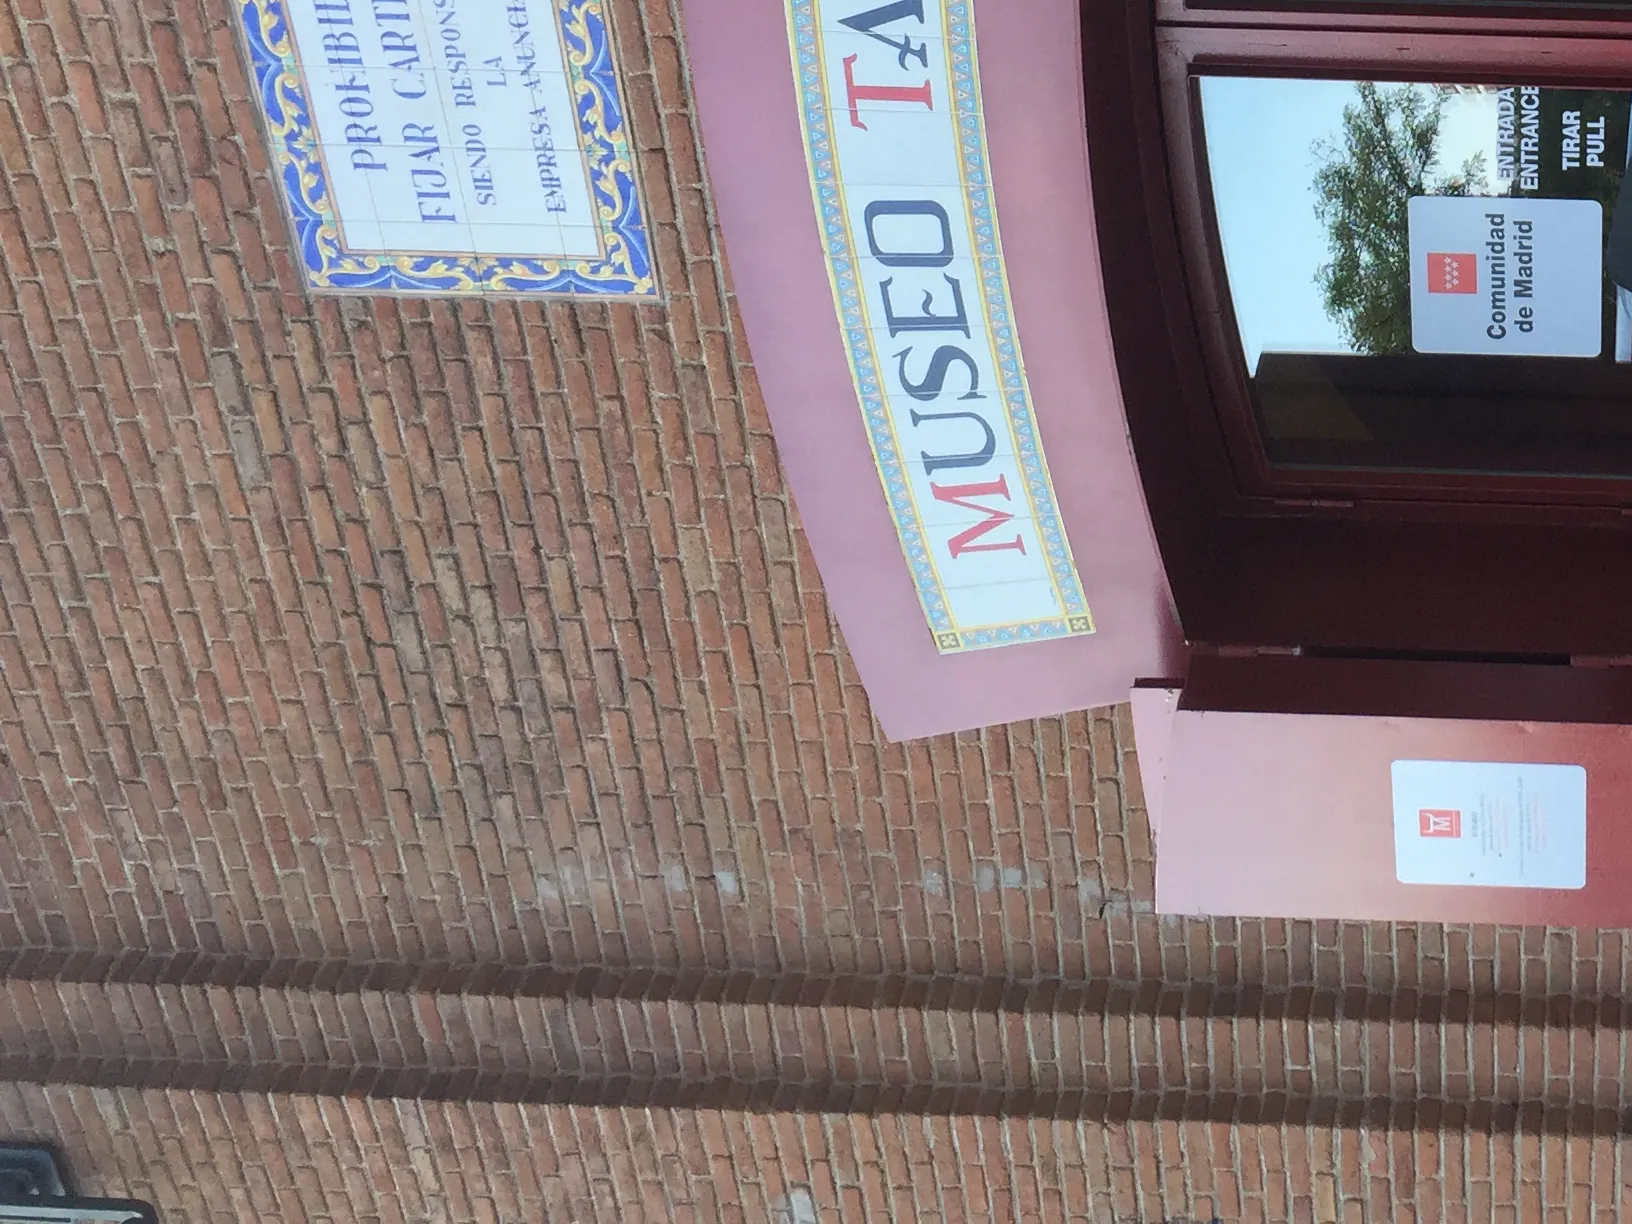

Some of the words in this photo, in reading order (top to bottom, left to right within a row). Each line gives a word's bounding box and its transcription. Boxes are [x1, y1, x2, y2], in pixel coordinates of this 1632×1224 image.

[484, 55, 508, 87] LA
[401, 123, 458, 223] FIJAR
[464, 124, 497, 206] SIENDO
[528, 106, 567, 213] EMPRESA
[1496, 87, 1515, 181] ENTRADA
[1520, 86, 1539, 190] ENTRANCE
[1562, 111, 1581, 171] TIRAR
[1586, 116, 1605, 167] PULL
[1485, 213, 1507, 340] Comunidad
[1513, 220, 1534, 298] Madrid
[1514, 306, 1534, 333] de
[863, 199, 1026, 560] MUSEO
